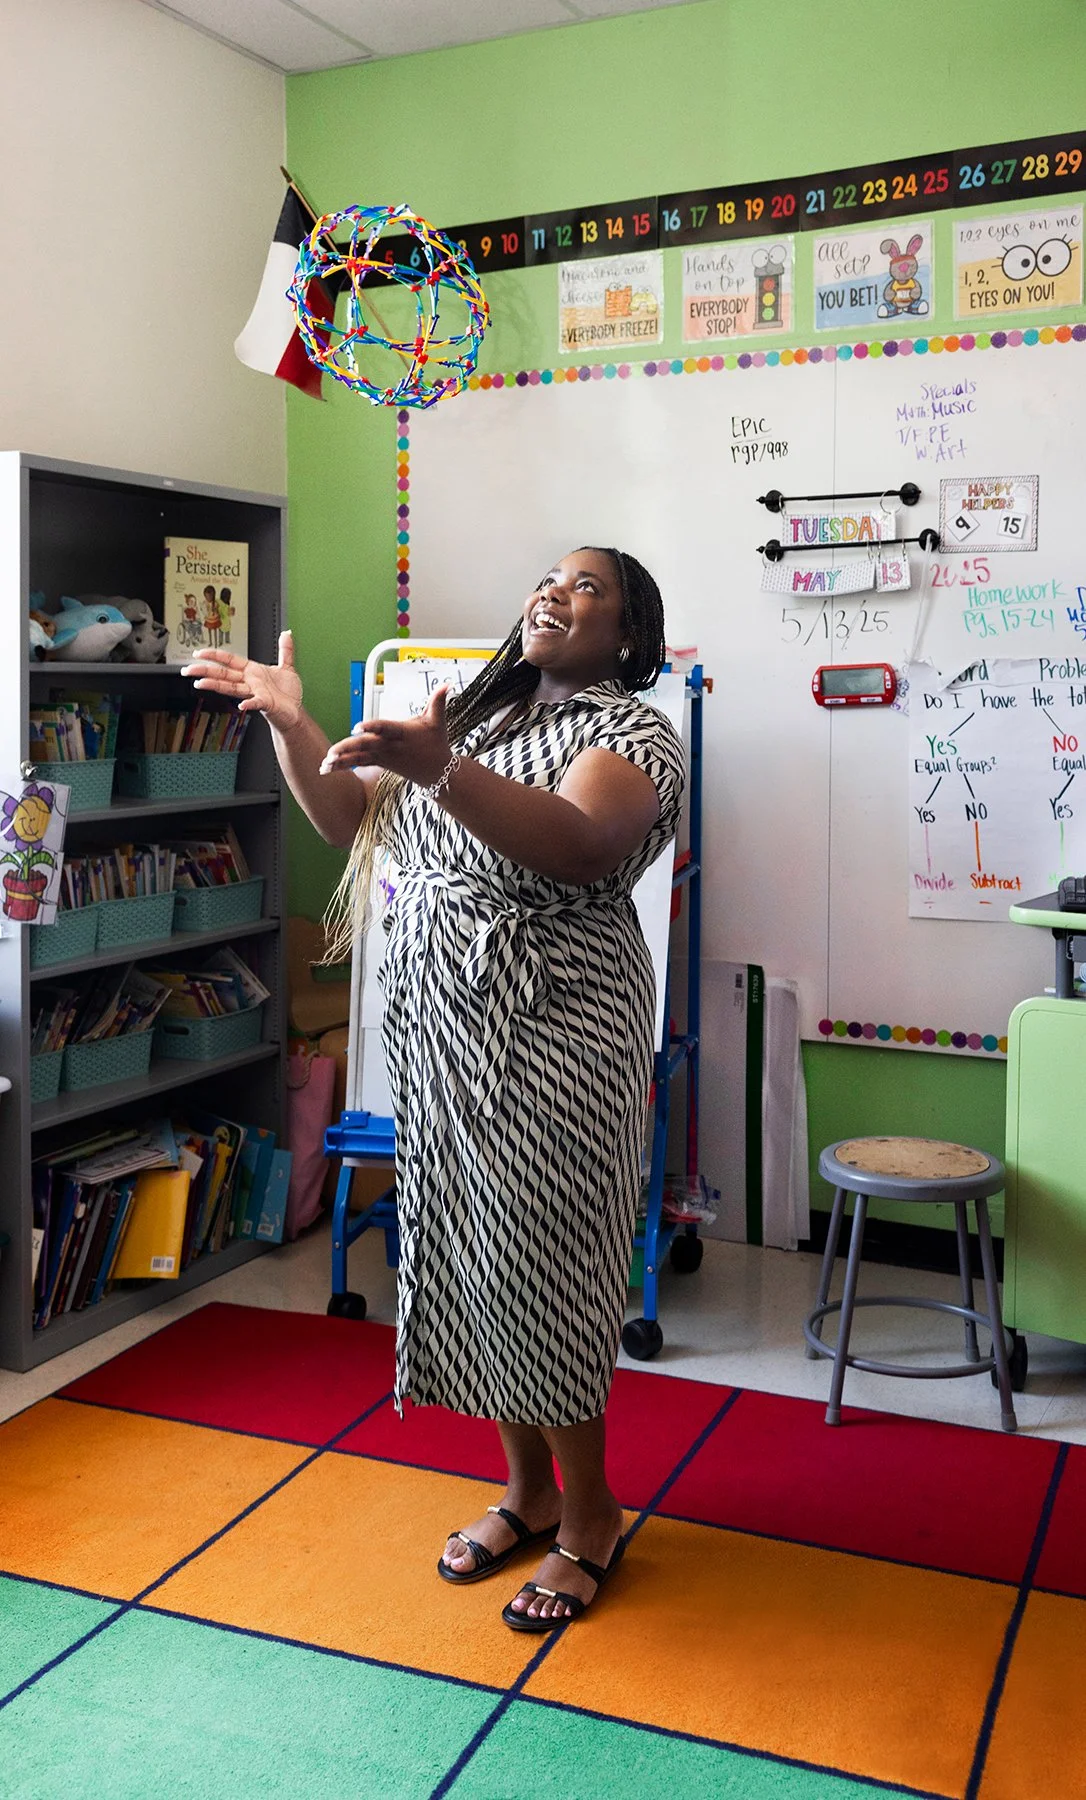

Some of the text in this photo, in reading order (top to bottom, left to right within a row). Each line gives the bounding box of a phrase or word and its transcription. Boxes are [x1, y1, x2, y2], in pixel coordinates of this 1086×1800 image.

[410, 247, 421, 267] 6
[480, 236, 492, 257] 9
[502, 233, 519, 254] 10
[531, 228, 546, 250] 11
[555, 225, 572, 246] 12
[580, 220, 598, 242] 13
[605, 217, 624, 239] 14
[632, 213, 651, 236] 15
[662, 209, 681, 231] 16
[690, 205, 709, 228] 17
[717, 201, 736, 224] 18
[744, 198, 765, 221] 19
[771, 194, 796, 218] 20
[805, 189, 826, 214] 21
[832, 185, 858, 209] 22
[862, 179, 888, 205] 23
[891, 174, 918, 200] 24
[923, 169, 949, 194] 25
[959, 164, 985, 190] 26
[990, 159, 1017, 185] 27
[1021, 154, 1049, 180] 28
[1055, 149, 1083, 176] 29
[987, 222, 1020, 241] eyes
[1028, 218, 1051, 233] on
[817, 241, 849, 262] All
[686, 254, 735, 276] Hands
[834, 254, 871, 278] set?
[695, 274, 745, 293] on top
[818, 283, 879, 310] YOU BET!
[969, 281, 1055, 309] EYES ON YOU!
[690, 297, 749, 319] EVERYBODY
[620, 318, 658, 337] FREEZE!
[706, 316, 737, 336] STOP!
[935, 438, 968, 463] Art
[967, 482, 1014, 497] HAPPY
[961, 498, 1015, 511] HELPERS
[790, 515, 882, 543] TUESDAY
[1002, 516, 1022, 535] 15
[186, 545, 208, 561] She
[175, 555, 241, 577] Persisted
[792, 562, 903, 592] MAY 13
[967, 578, 1067, 607] Homework
[781, 600, 890, 651] 5/13/25
[1001, 607, 1055, 633] 15-24
[1039, 657, 1086, 681] Proble
[924, 693, 944, 710] Do
[952, 693, 964, 710] I
[980, 688, 1018, 709] have
[1029, 687, 1054, 707] the
[926, 734, 958, 758] Yes
[1052, 734, 1079, 753] NO
[914, 756, 998, 775] Equal Groups?
[1053, 756, 1086, 776] Equal
[914, 805, 936, 824] Yes
[965, 802, 988, 821] NO
[1049, 797, 1074, 820] Yes
[970, 872, 1023, 890] Subtract
